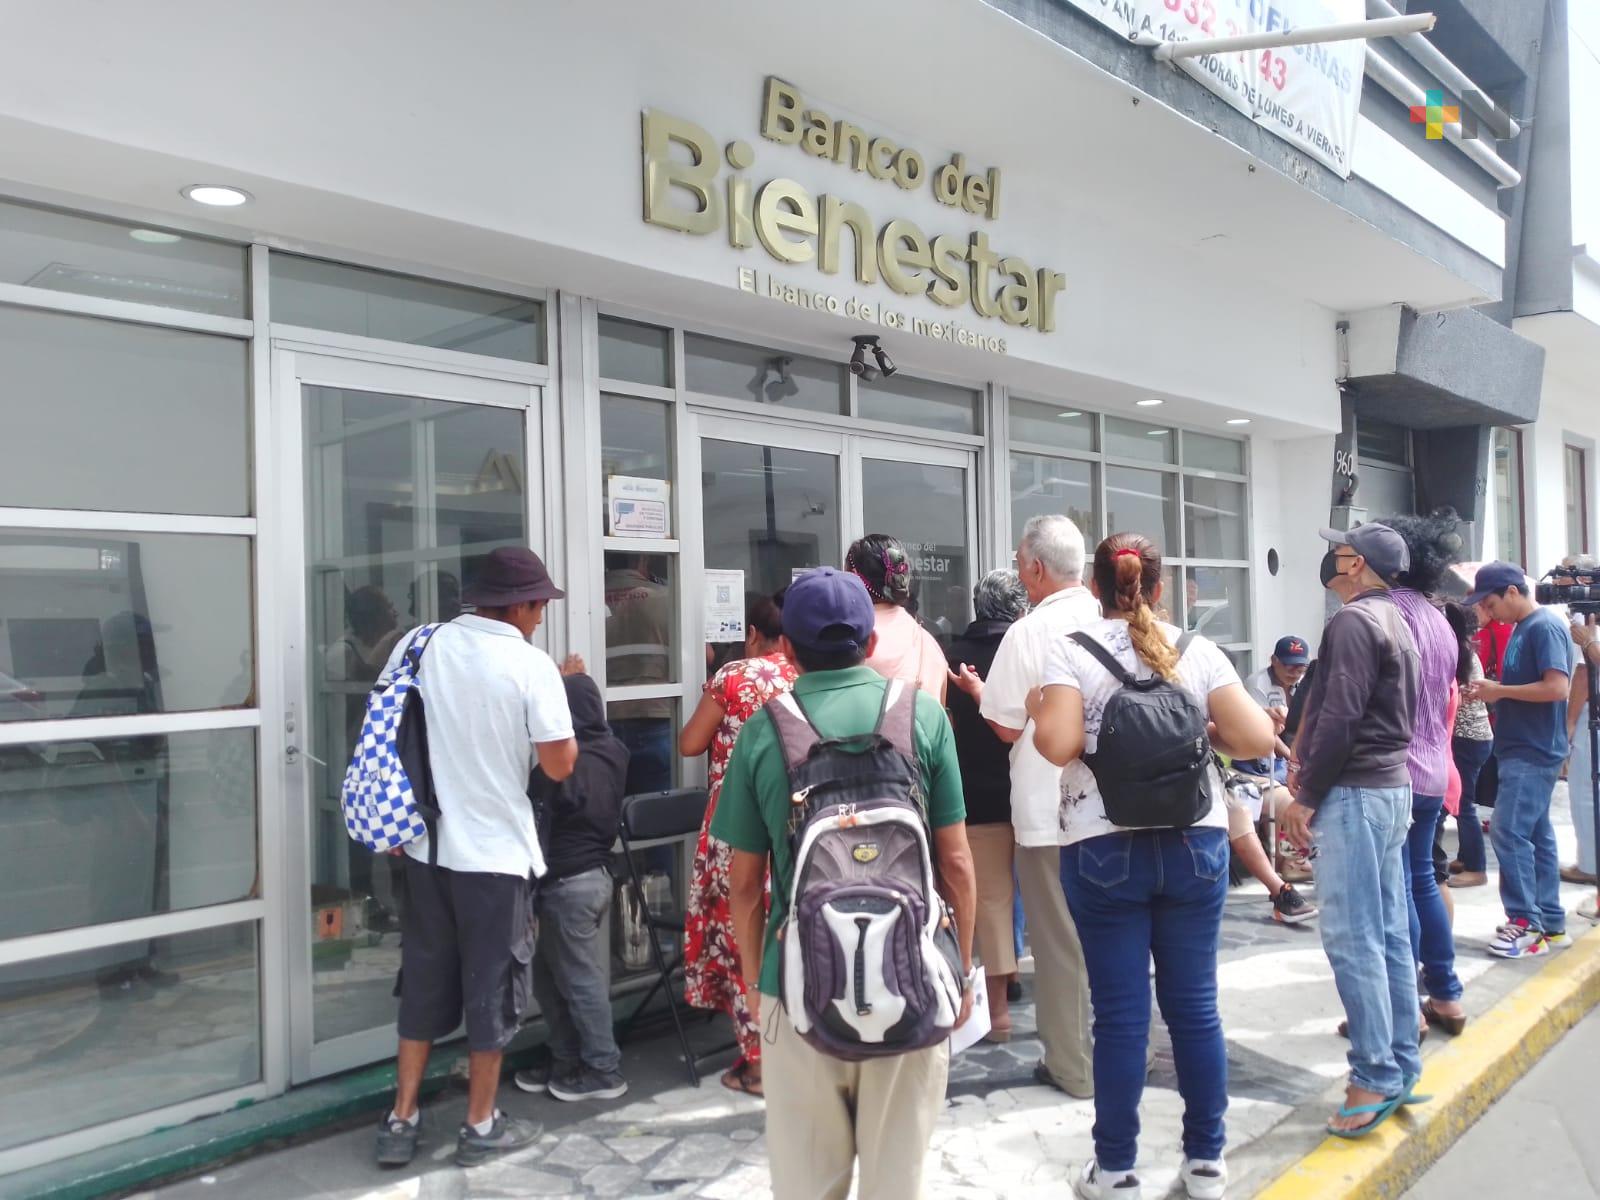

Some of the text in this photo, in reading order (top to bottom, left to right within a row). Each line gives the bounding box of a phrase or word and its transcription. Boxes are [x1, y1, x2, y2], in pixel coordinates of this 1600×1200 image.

[1140, 14, 1153, 34] A
[1199, 54, 1239, 91] HORAS
[1241, 80, 1256, 105] DE
[1258, 93, 1295, 128] LUNES
[1295, 119, 1303, 136] A
[1259, 49, 1288, 91] 43
[761, 75, 1000, 219] Banco del
[641, 106, 1066, 332] Bienestar
[739, 266, 1008, 353] El banco de los mexicanos
[1336, 450, 1353, 476] 960
